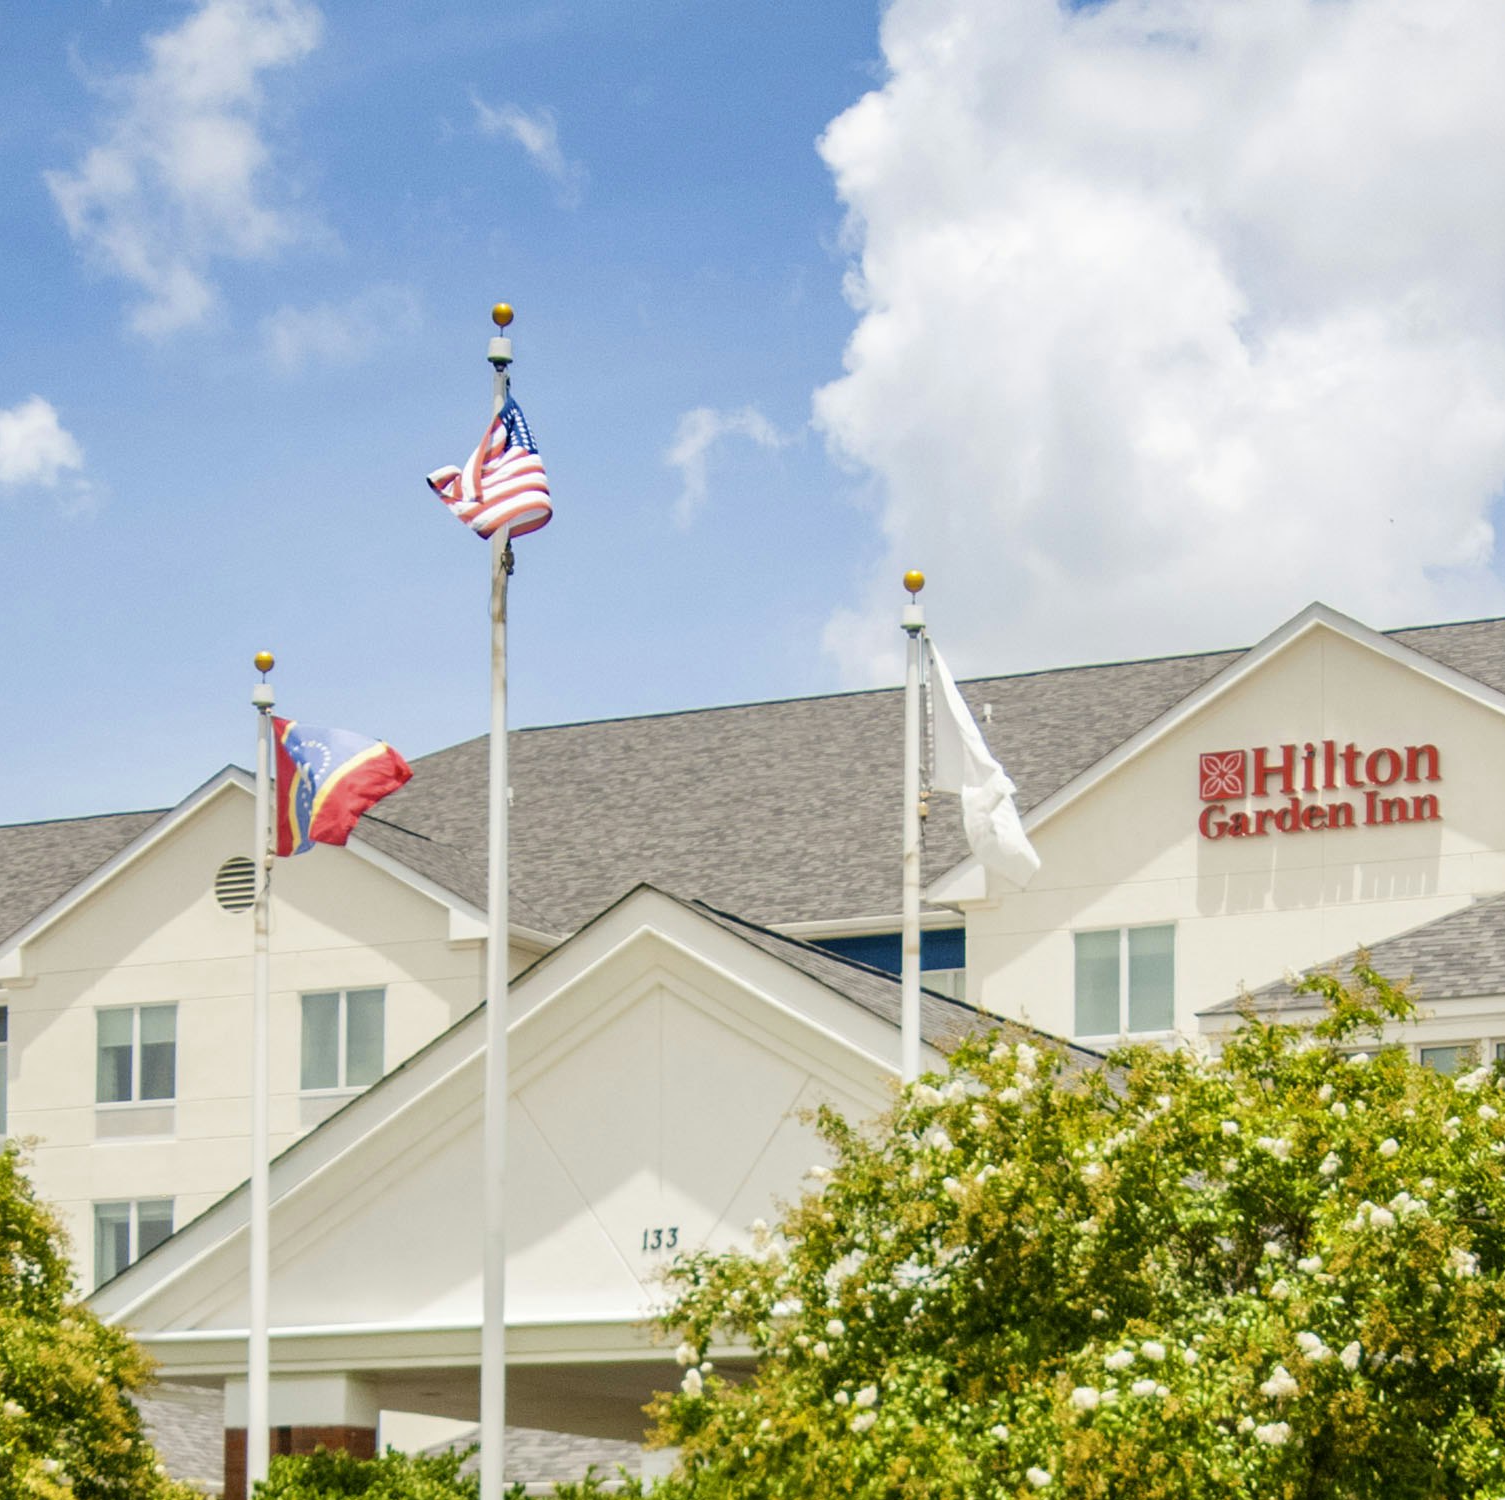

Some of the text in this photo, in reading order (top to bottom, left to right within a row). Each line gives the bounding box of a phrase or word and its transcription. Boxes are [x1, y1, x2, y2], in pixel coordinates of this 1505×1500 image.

[1251, 740, 1441, 797] Hilton
[1199, 790, 1442, 840] Garden Inn
[642, 1226, 679, 1251] 133
